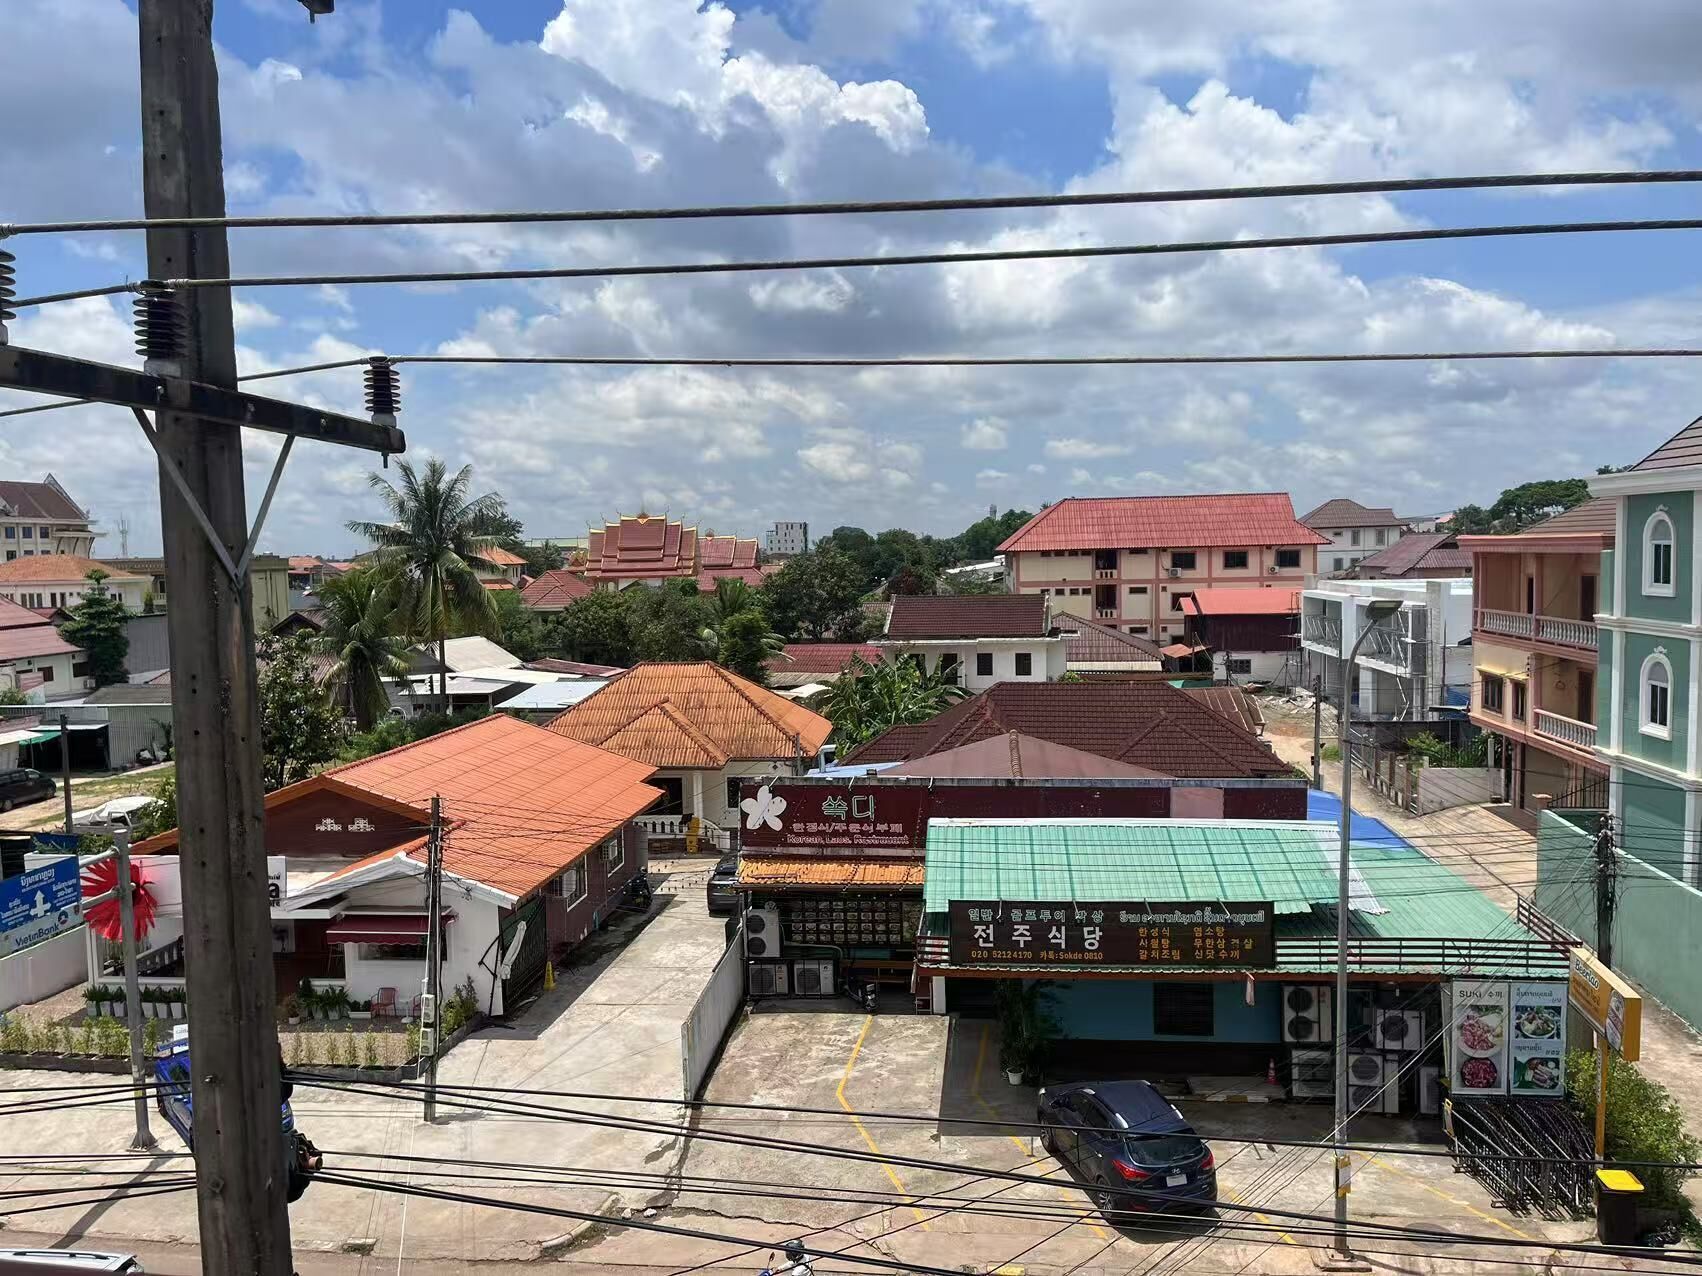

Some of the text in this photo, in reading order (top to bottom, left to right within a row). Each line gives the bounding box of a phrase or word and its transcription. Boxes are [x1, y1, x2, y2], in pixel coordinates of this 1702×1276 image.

[822, 795, 875, 821] 쏙디
[968, 908, 993, 922] 일반
[1010, 909, 1066, 923] 골프투어
[15, 923, 59, 946] VietinBank
[973, 924, 1103, 950] 전주식당
[971, 950, 988, 958] 020
[992, 951, 1032, 959] 52124170
[1458, 990, 1482, 998] SUKI
